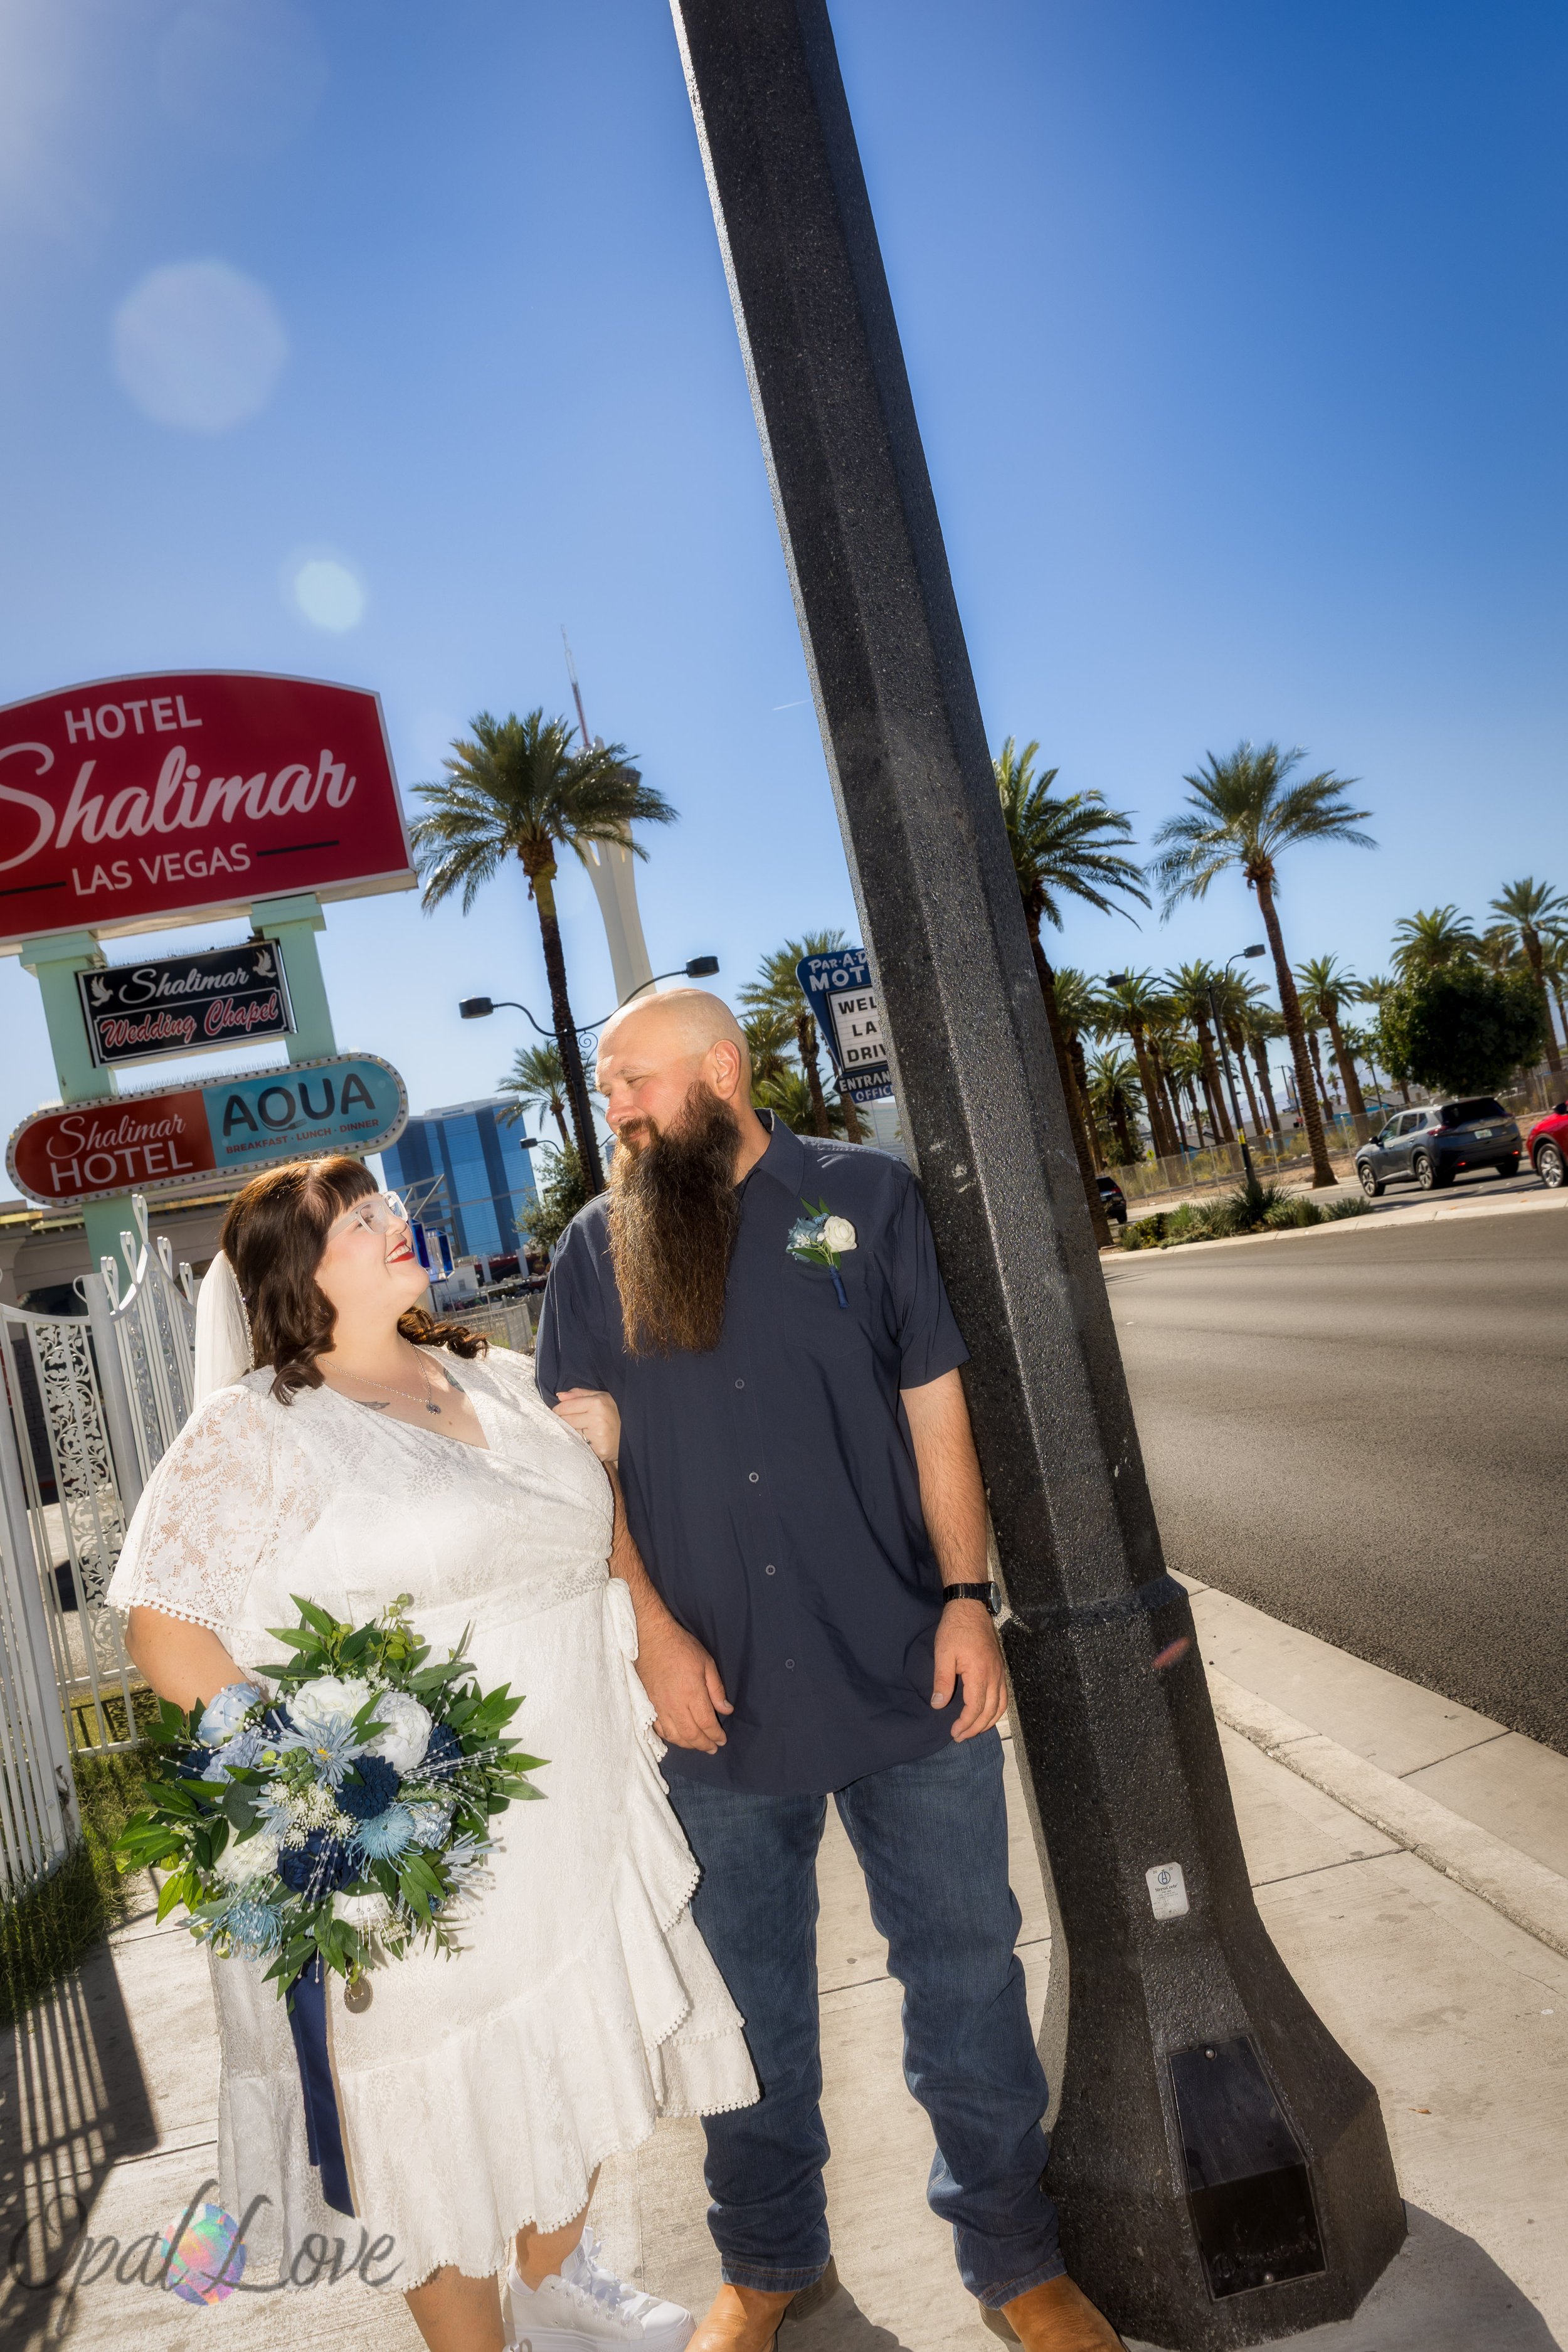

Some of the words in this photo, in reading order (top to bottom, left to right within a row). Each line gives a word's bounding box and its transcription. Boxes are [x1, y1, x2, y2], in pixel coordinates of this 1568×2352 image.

[65, 696, 202, 743] HOTEL
[0, 741, 356, 871] Shalimar
[72, 861, 132, 896] LAS
[138, 842, 252, 884] VEGAS
[118, 967, 249, 1004] Shalimar
[808, 965, 865, 992] MOT
[100, 1011, 197, 1049] Wedding
[204, 992, 279, 1036] Chapel
[852, 1020, 877, 1037] LA
[839, 1070, 891, 1092] ENTRAN
[223, 1073, 376, 1137] AQUA
[46, 1114, 186, 1160] Shalimar
[226, 1135, 289, 1154] BREAKFAST
[296, 1128, 332, 1142] LUNCH
[339, 1118, 379, 1133] DINNER
[50, 1140, 193, 1192] HOTEL
